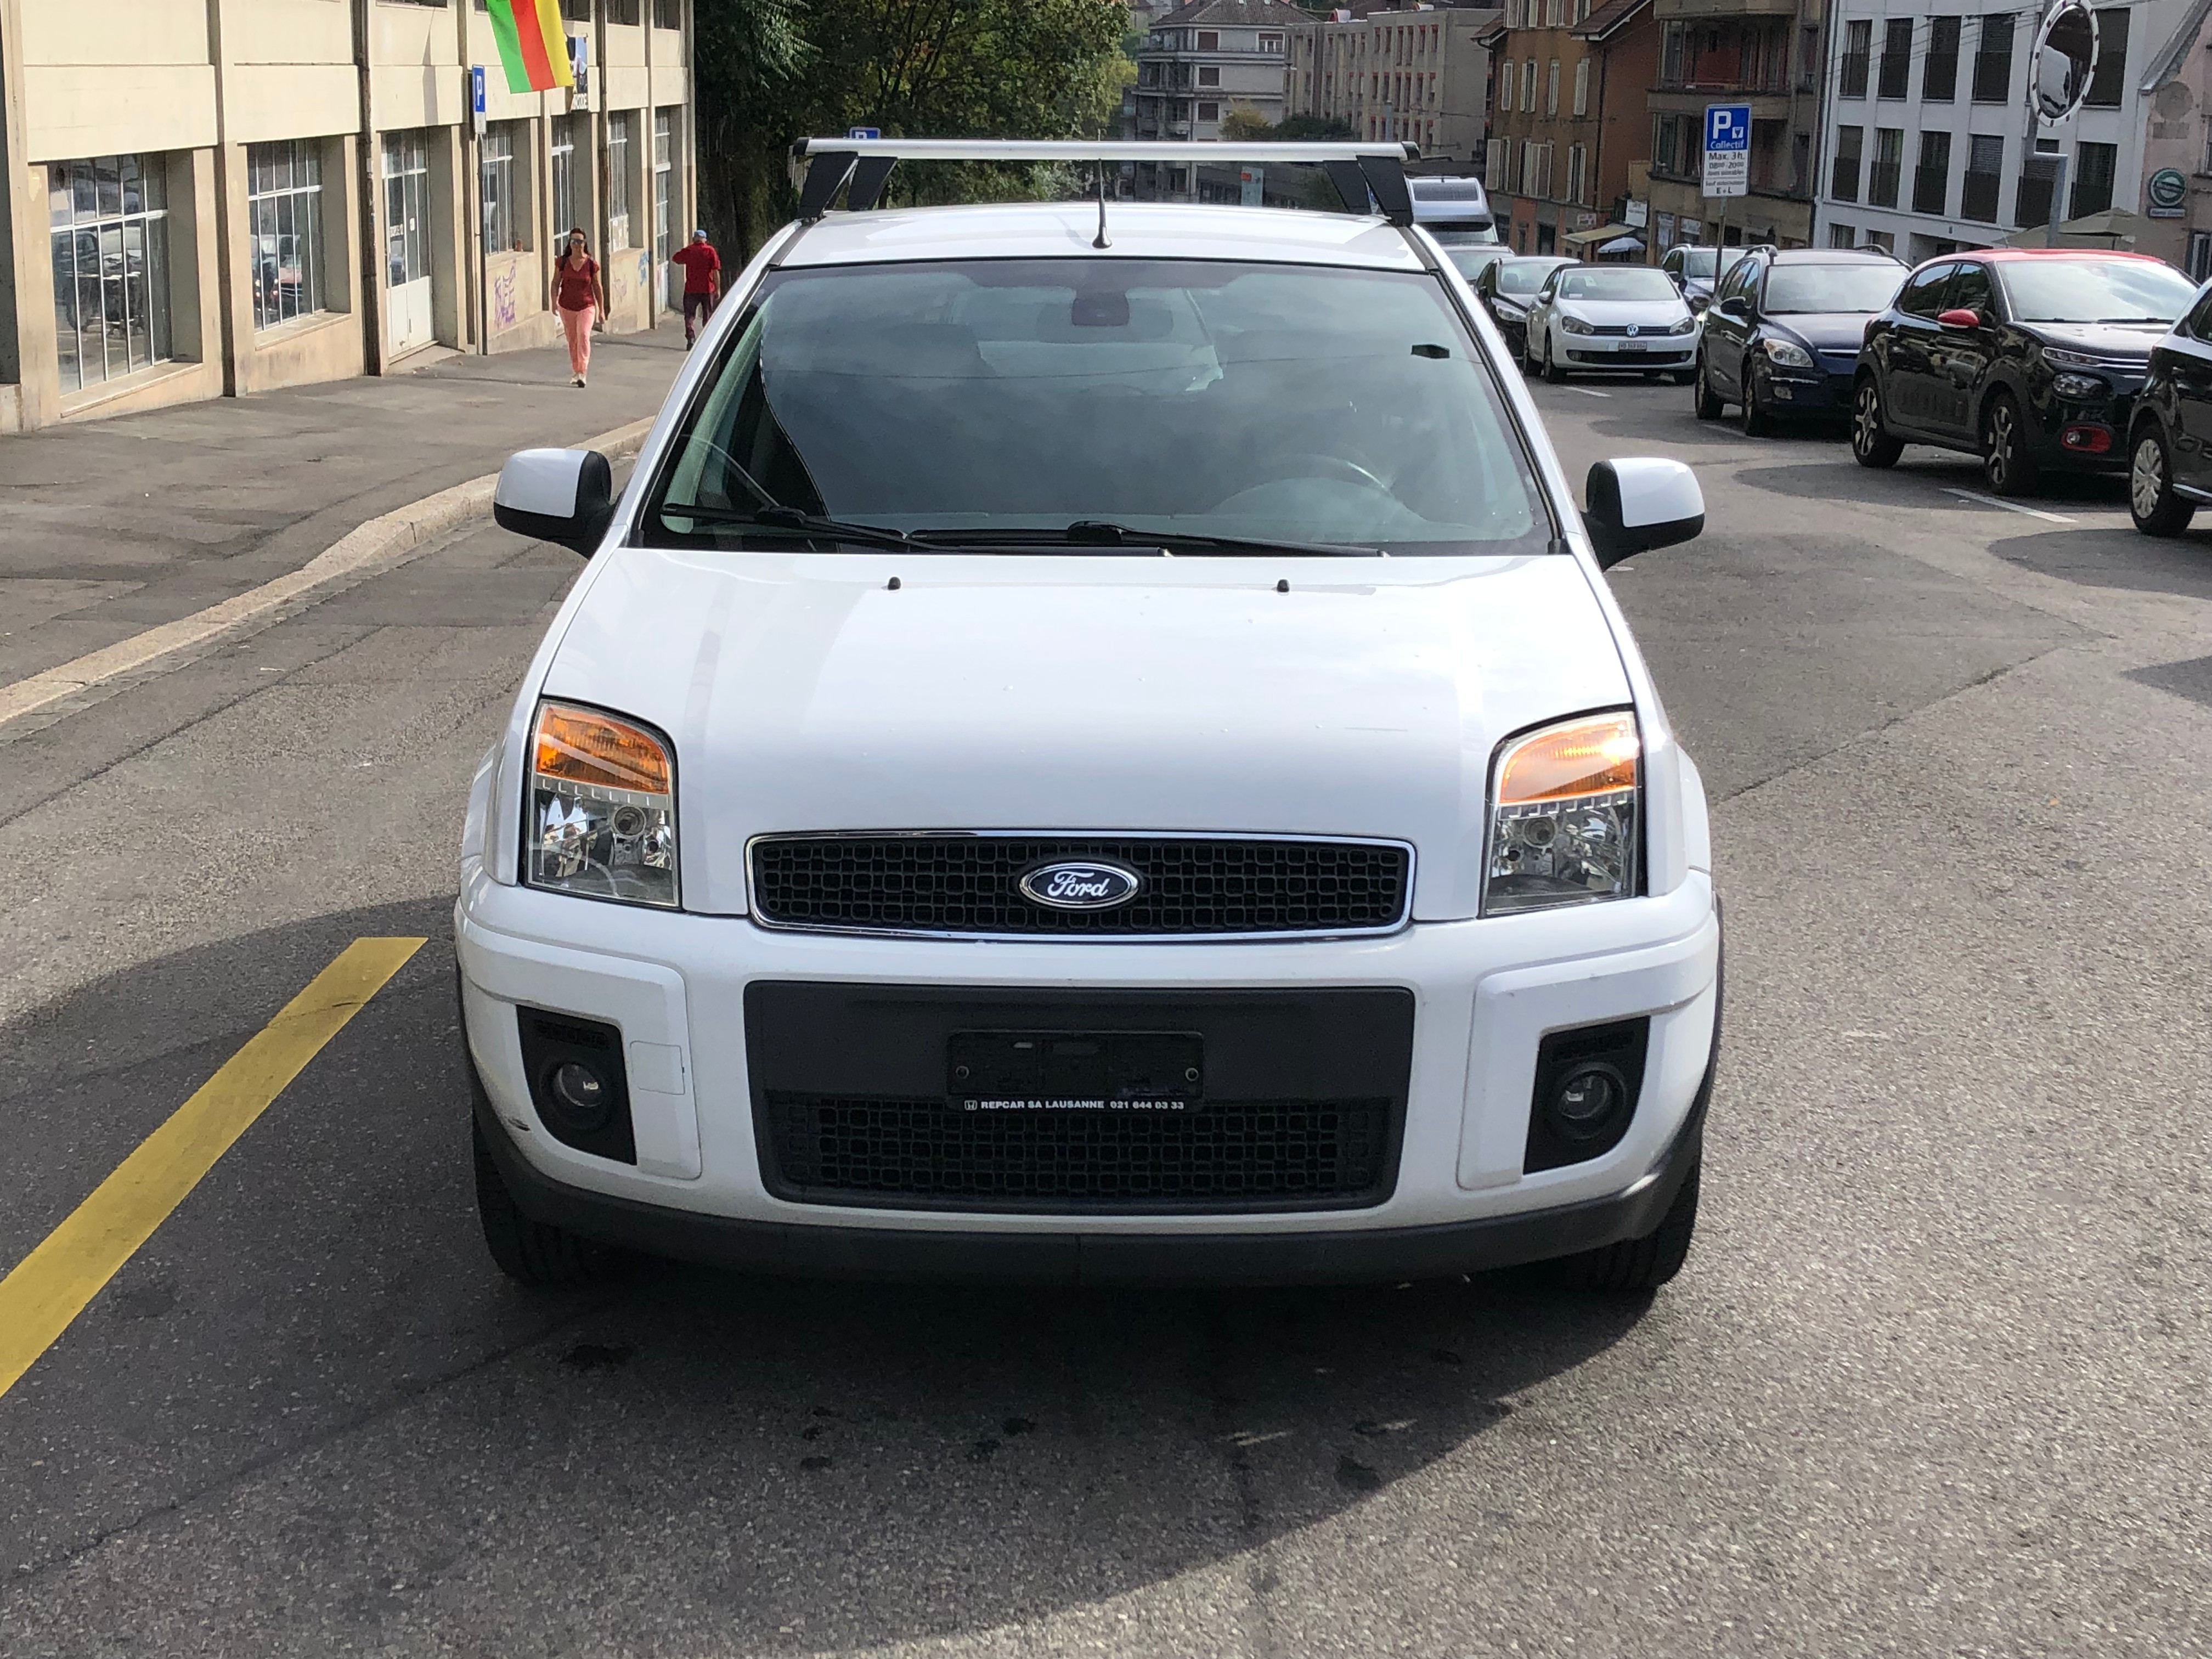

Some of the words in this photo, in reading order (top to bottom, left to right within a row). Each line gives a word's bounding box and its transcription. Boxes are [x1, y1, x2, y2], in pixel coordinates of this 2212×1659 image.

[476, 75, 483, 106] P
[1713, 111, 1732, 139] P
[1710, 140, 1745, 149] Collectif
[1047, 871, 1110, 896] Ford
[981, 1101, 1025, 1109] REPCAR
[1028, 1100, 1042, 1109] SA
[1045, 1100, 1104, 1109] LAUSANNE
[1110, 1101, 1128, 1109] 021
[1132, 1101, 1152, 1109] 644
[1155, 1101, 1168, 1109] 03
[1171, 1101, 1184, 1109] 33
